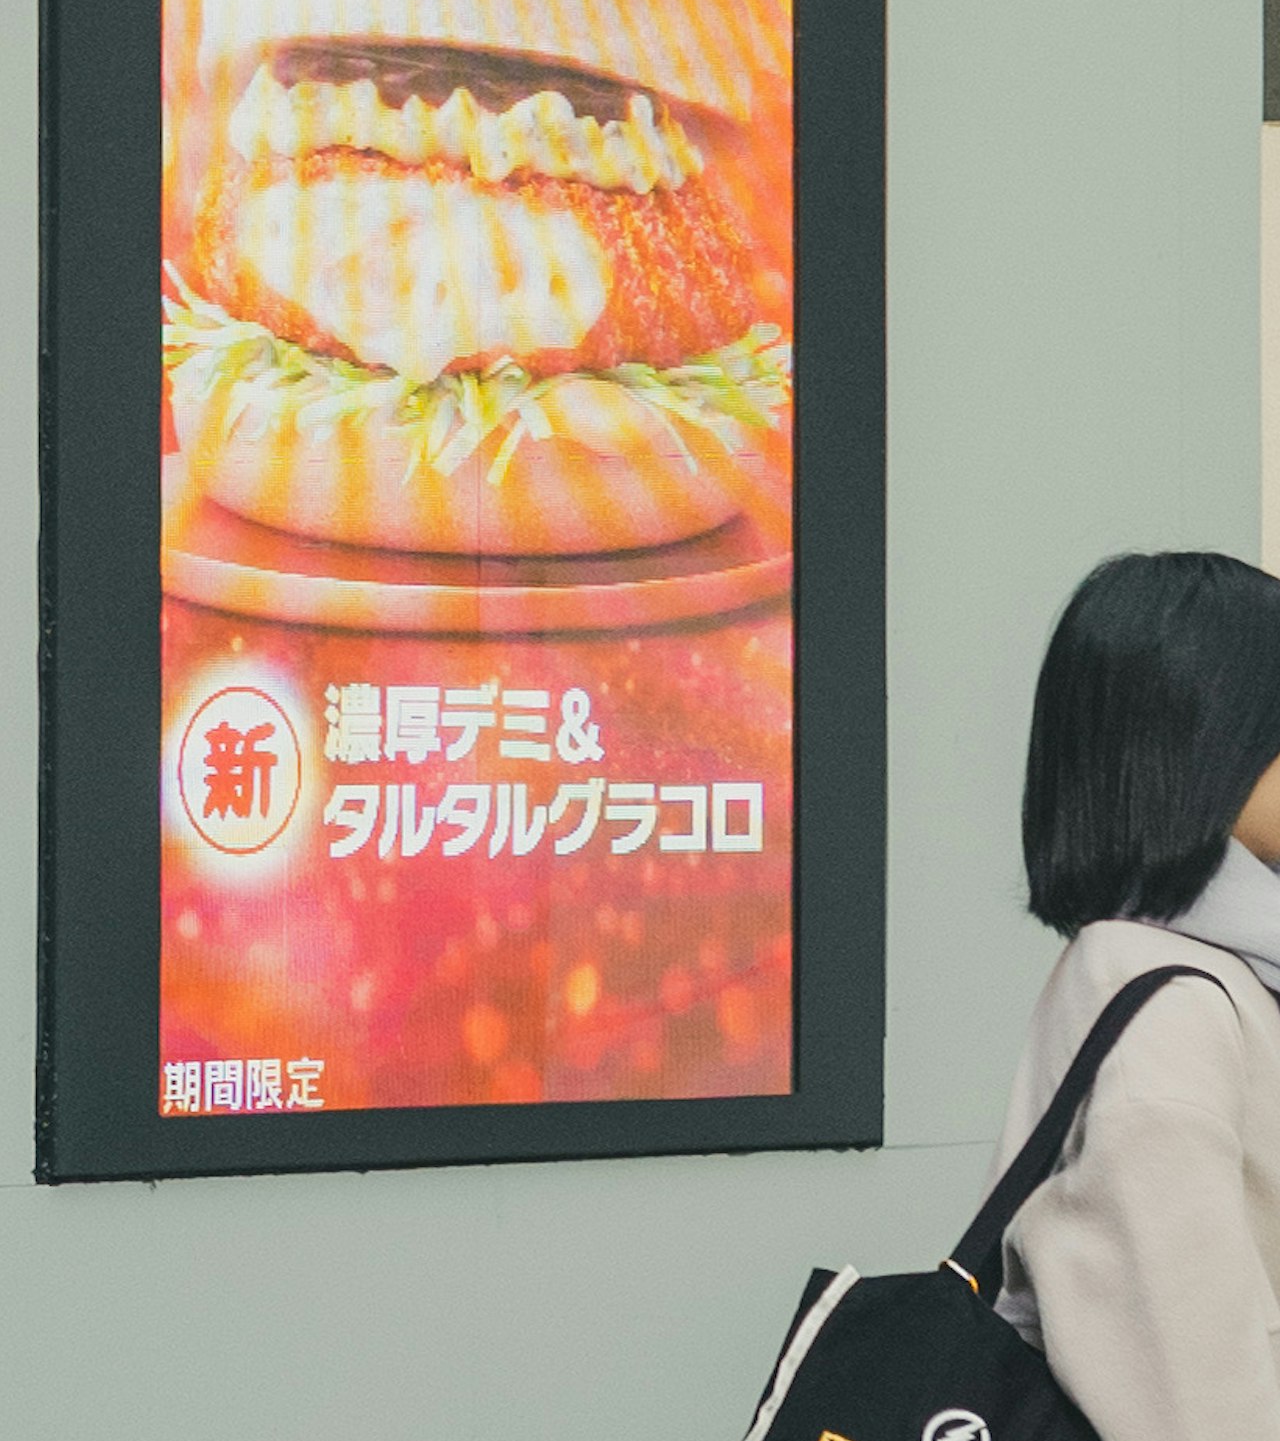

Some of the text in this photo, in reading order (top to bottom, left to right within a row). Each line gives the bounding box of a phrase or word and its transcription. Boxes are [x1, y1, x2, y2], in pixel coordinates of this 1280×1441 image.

[323, 683, 604, 763] 濃厚デミ&
[201, 720, 279, 822] 新
[323, 777, 763, 859] タルタルグラコロ
[162, 1057, 325, 1114] 期間限定
